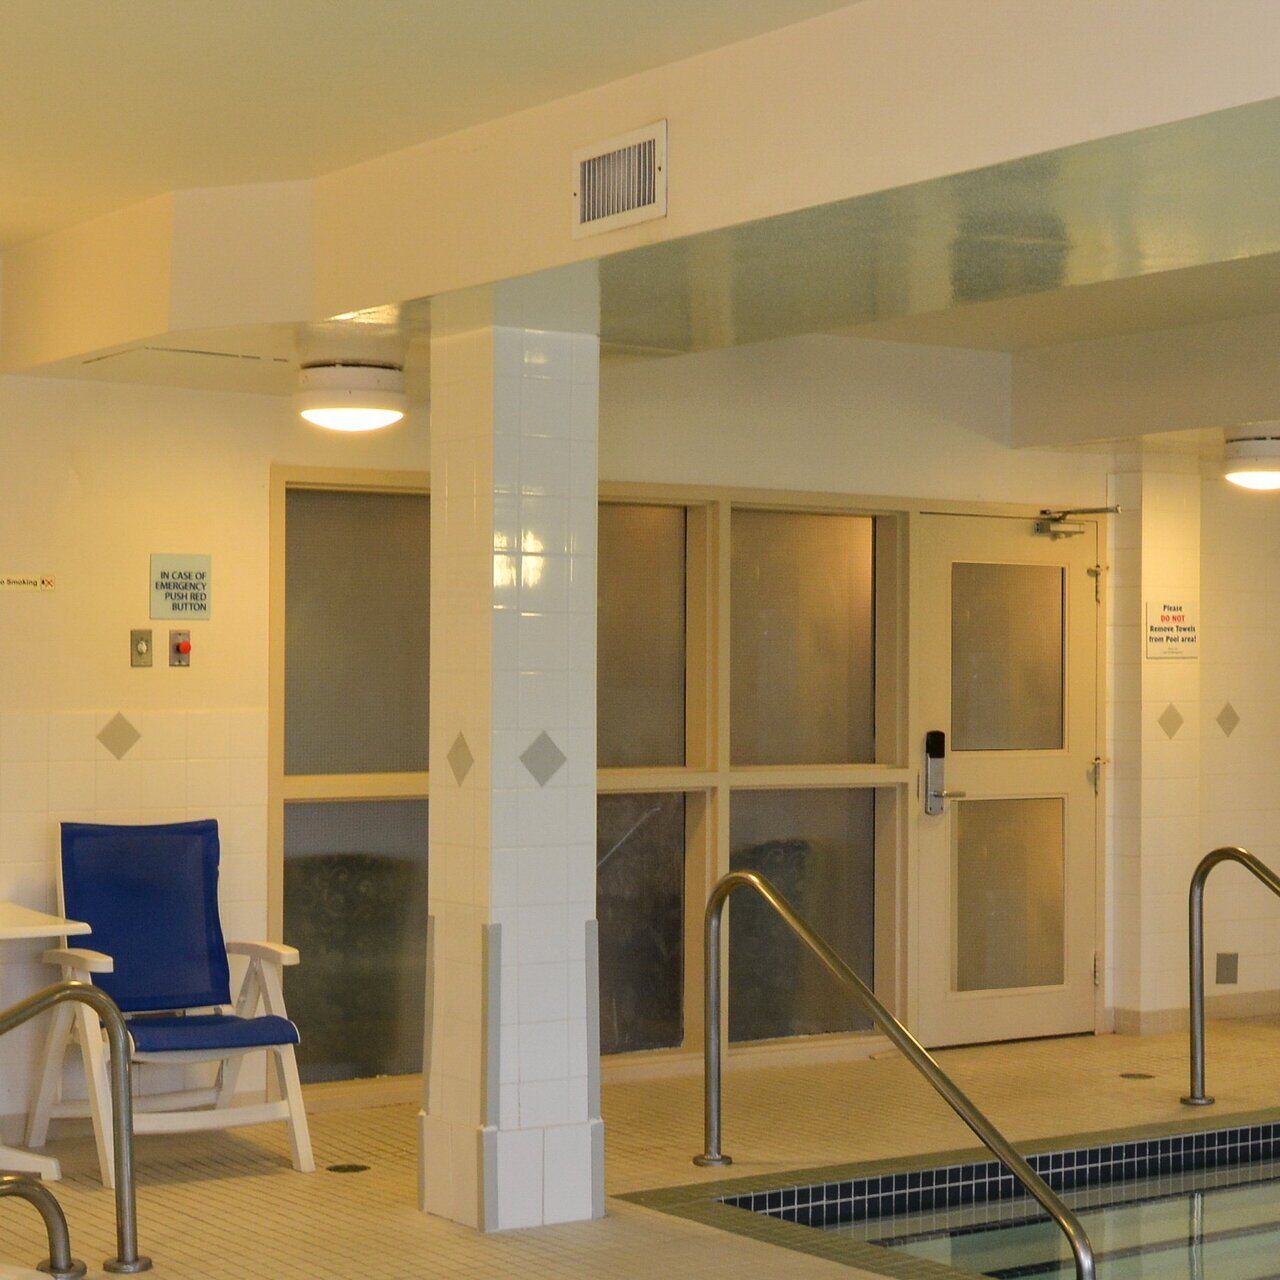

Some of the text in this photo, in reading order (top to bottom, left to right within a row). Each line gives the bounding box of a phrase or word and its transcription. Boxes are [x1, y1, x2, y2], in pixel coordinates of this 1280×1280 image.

[160, 571, 207, 580] IN CASE OF
[155, 582, 207, 590] EMERGENCY
[164, 592, 207, 601] PUSH RED
[172, 603, 207, 611] BUTTON
